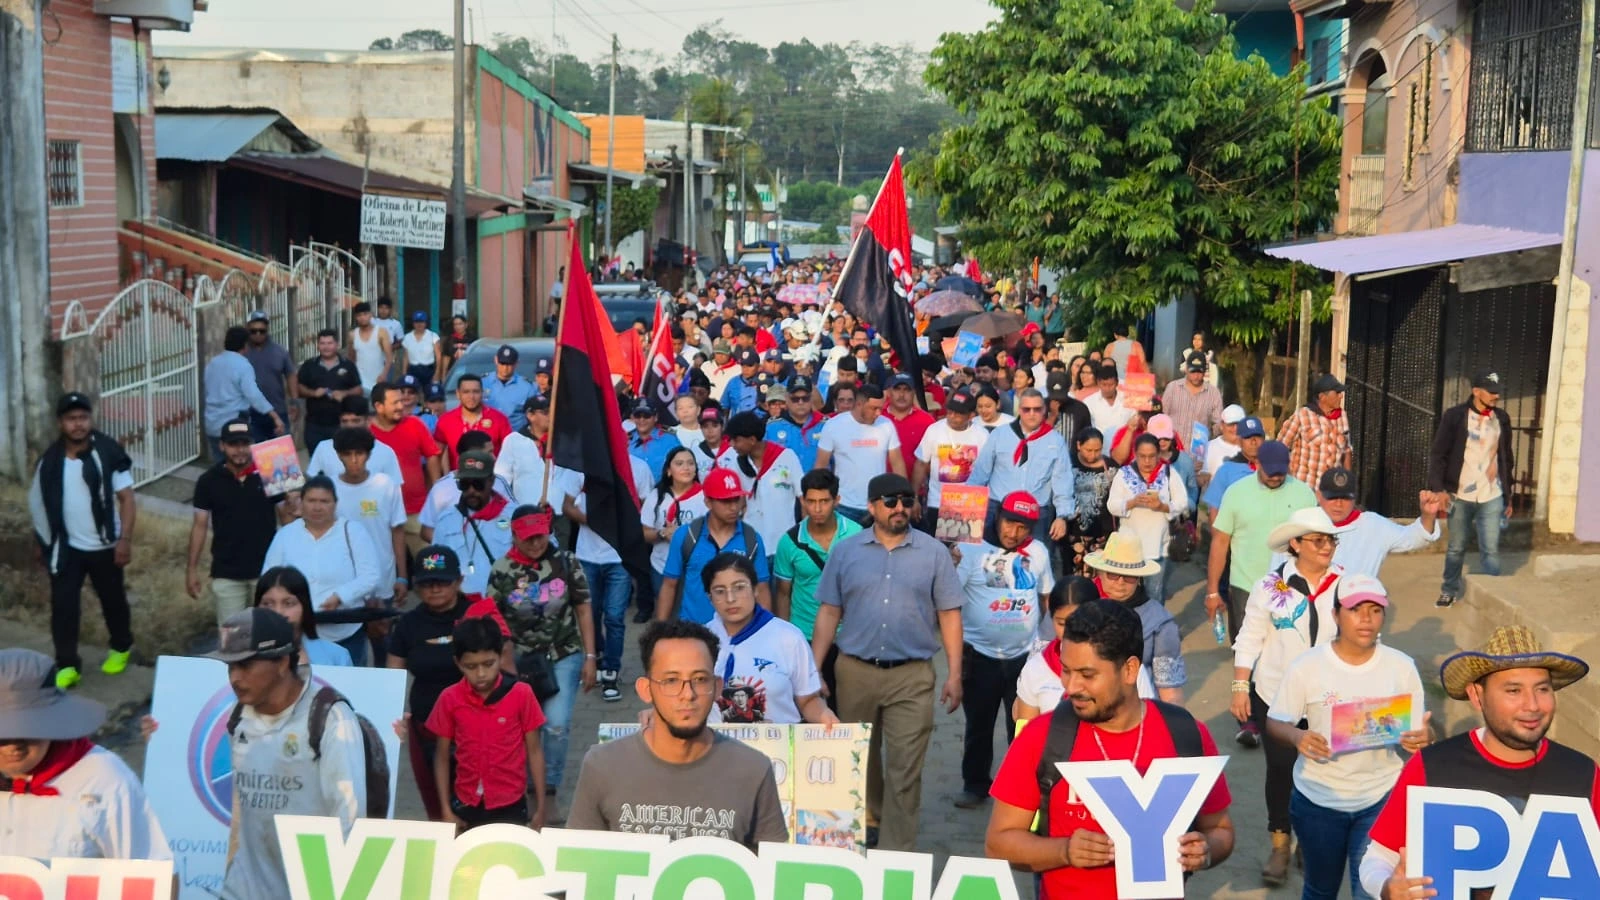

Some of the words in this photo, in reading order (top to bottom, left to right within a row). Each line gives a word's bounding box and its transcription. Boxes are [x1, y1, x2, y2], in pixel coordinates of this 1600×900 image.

[364, 196, 401, 211] Oficina
[403, 200, 415, 212] de
[380, 212, 409, 229] Roberto
[236, 769, 303, 791] mirates
[618, 803, 736, 828] AMERICAN
[1086, 773, 1200, 883] Y
